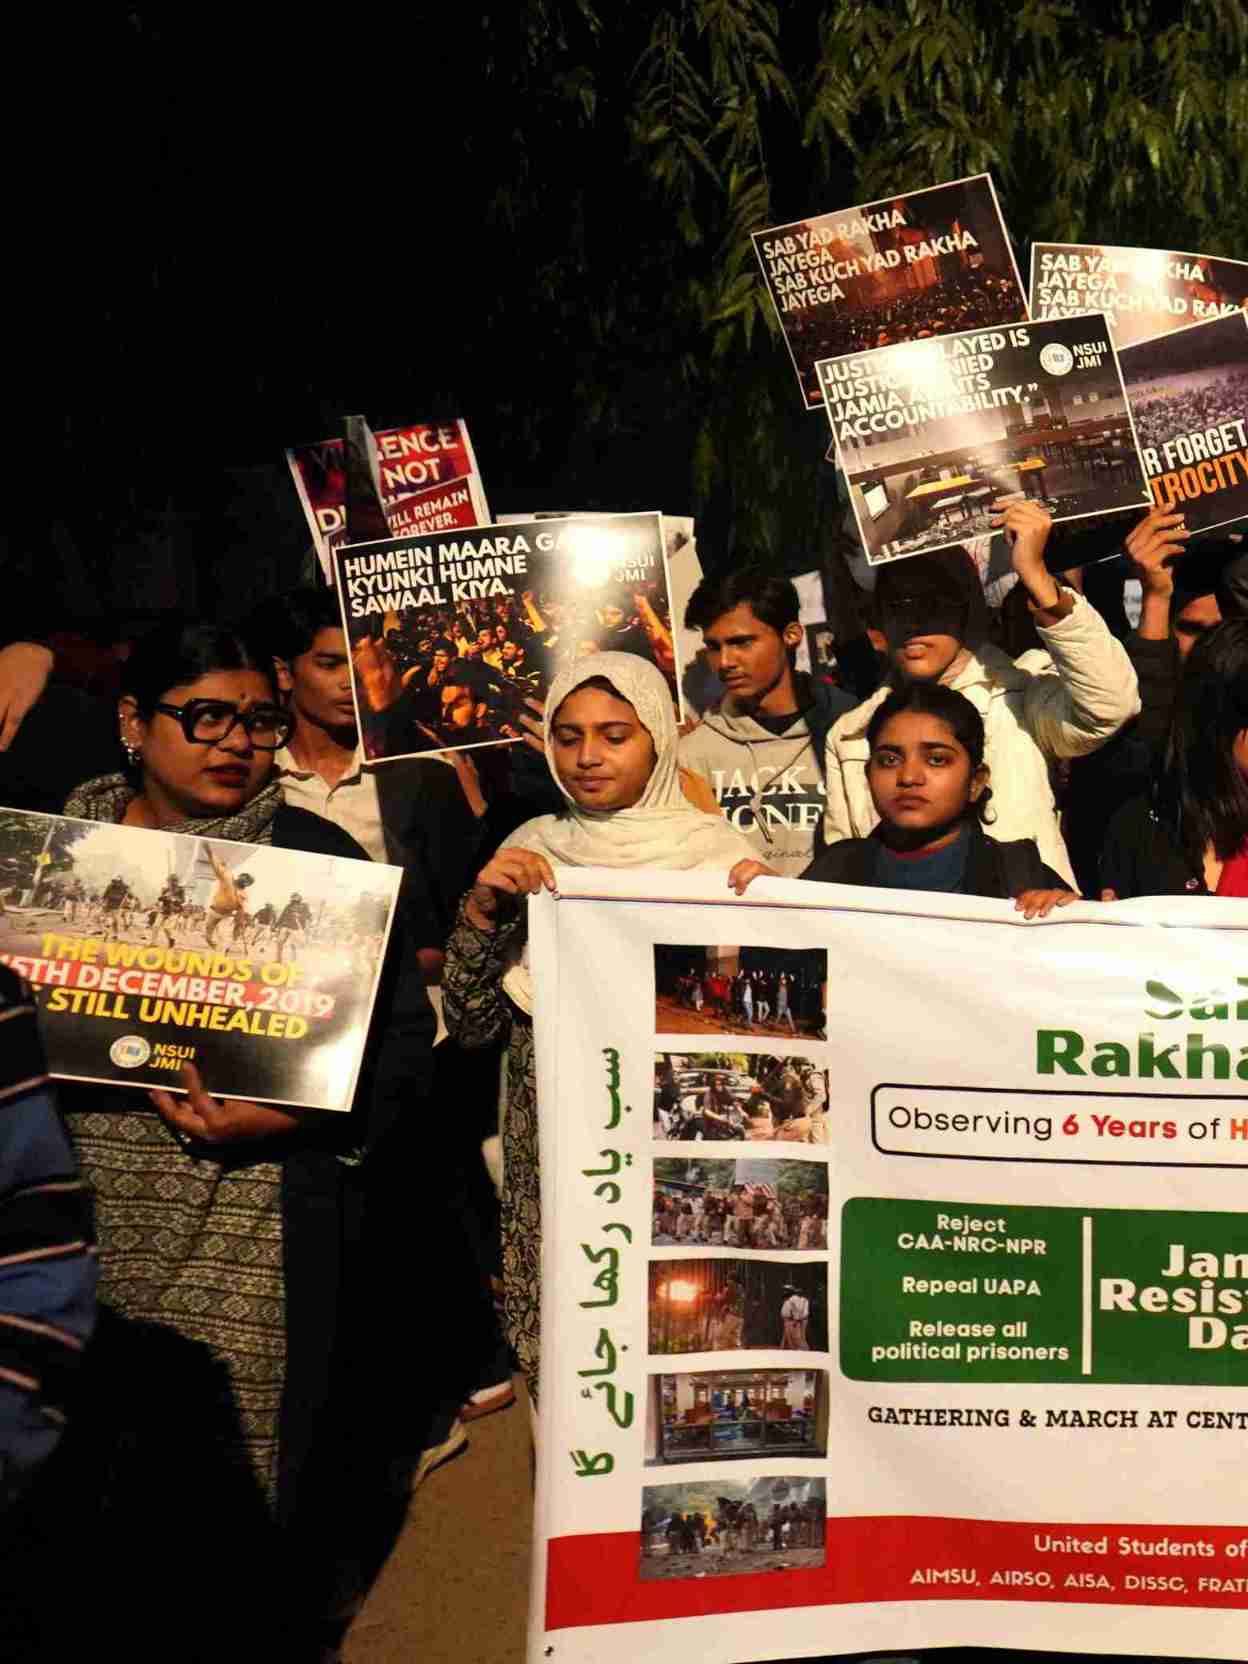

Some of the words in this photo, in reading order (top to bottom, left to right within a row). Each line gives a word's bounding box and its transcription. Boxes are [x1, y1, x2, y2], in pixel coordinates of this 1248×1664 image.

[763, 233, 797, 260] SAB
[795, 227, 834, 250] YAD
[836, 208, 908, 241] RAKHA
[769, 247, 835, 278] JAYEGA
[774, 271, 807, 295] SAB
[808, 257, 862, 285] KUCH
[861, 249, 902, 272] YAD
[902, 228, 979, 263] RAKHA
[1040, 253, 1081, 272] SAB
[1037, 271, 1119, 291] JAYEGA
[1038, 287, 1082, 306] SAB
[780, 282, 846, 313] JAYEGA
[1009, 328, 1031, 348] IS
[1073, 341, 1108, 358] NSUI
[1076, 356, 1102, 370] JMI
[834, 390, 906, 422] JAMIA
[376, 427, 459, 462] ENCE
[1161, 418, 1248, 470] FORGET
[383, 457, 441, 489] NOT
[413, 489, 470, 520] REMAIN
[345, 547, 433, 579] HUMEIN
[439, 535, 531, 564] MAARA
[347, 567, 434, 598] KYUNKI
[440, 554, 528, 583] HUMNE
[351, 587, 447, 619] SAWAAL
[452, 576, 514, 603] KIYA.
[719, 803, 824, 834] JONE
[40, 932, 98, 960] THE
[103, 940, 253, 983] WOUNDS
[1, 954, 70, 988] 5TH
[76, 963, 251, 1012] DECEMBER,
[257, 986, 337, 1018] 2019
[46, 988, 130, 1021] STILL
[138, 996, 309, 1040] UNHEALED
[148, 1057, 182, 1073] JMI
[153, 1042, 196, 1061] NSUI
[601, 1047, 633, 1130] سب
[888, 1105, 1053, 1141] Observing
[1062, 1113, 1080, 1137] 6
[1089, 1114, 1178, 1140] Years
[1188, 1118, 1221, 1141] of
[936, 1213, 1007, 1235] Reject
[897, 1233, 1047, 1256] CAA-NRC-NPR
[902, 1275, 978, 1297] Repeal
[983, 1278, 1042, 1297] UAPA
[909, 1320, 997, 1338] Release
[1001, 1321, 1028, 1339] all
[871, 1342, 961, 1363] political
[966, 1342, 1070, 1364] prisoners
[867, 1406, 1011, 1428] GATHERING
[1018, 1408, 1038, 1428] &
[1044, 1409, 1139, 1429] MARCH
[1146, 1411, 1178, 1429] AT
[1033, 1534, 1108, 1555] United
[1117, 1536, 1216, 1559] Students
[1224, 1538, 1248, 1559] of
[909, 1567, 982, 1588] AIMSU,
[989, 1570, 1056, 1590] AIRSO,
[1063, 1572, 1116, 1592] AISA,
[1124, 1574, 1190, 1594] DISSC,
